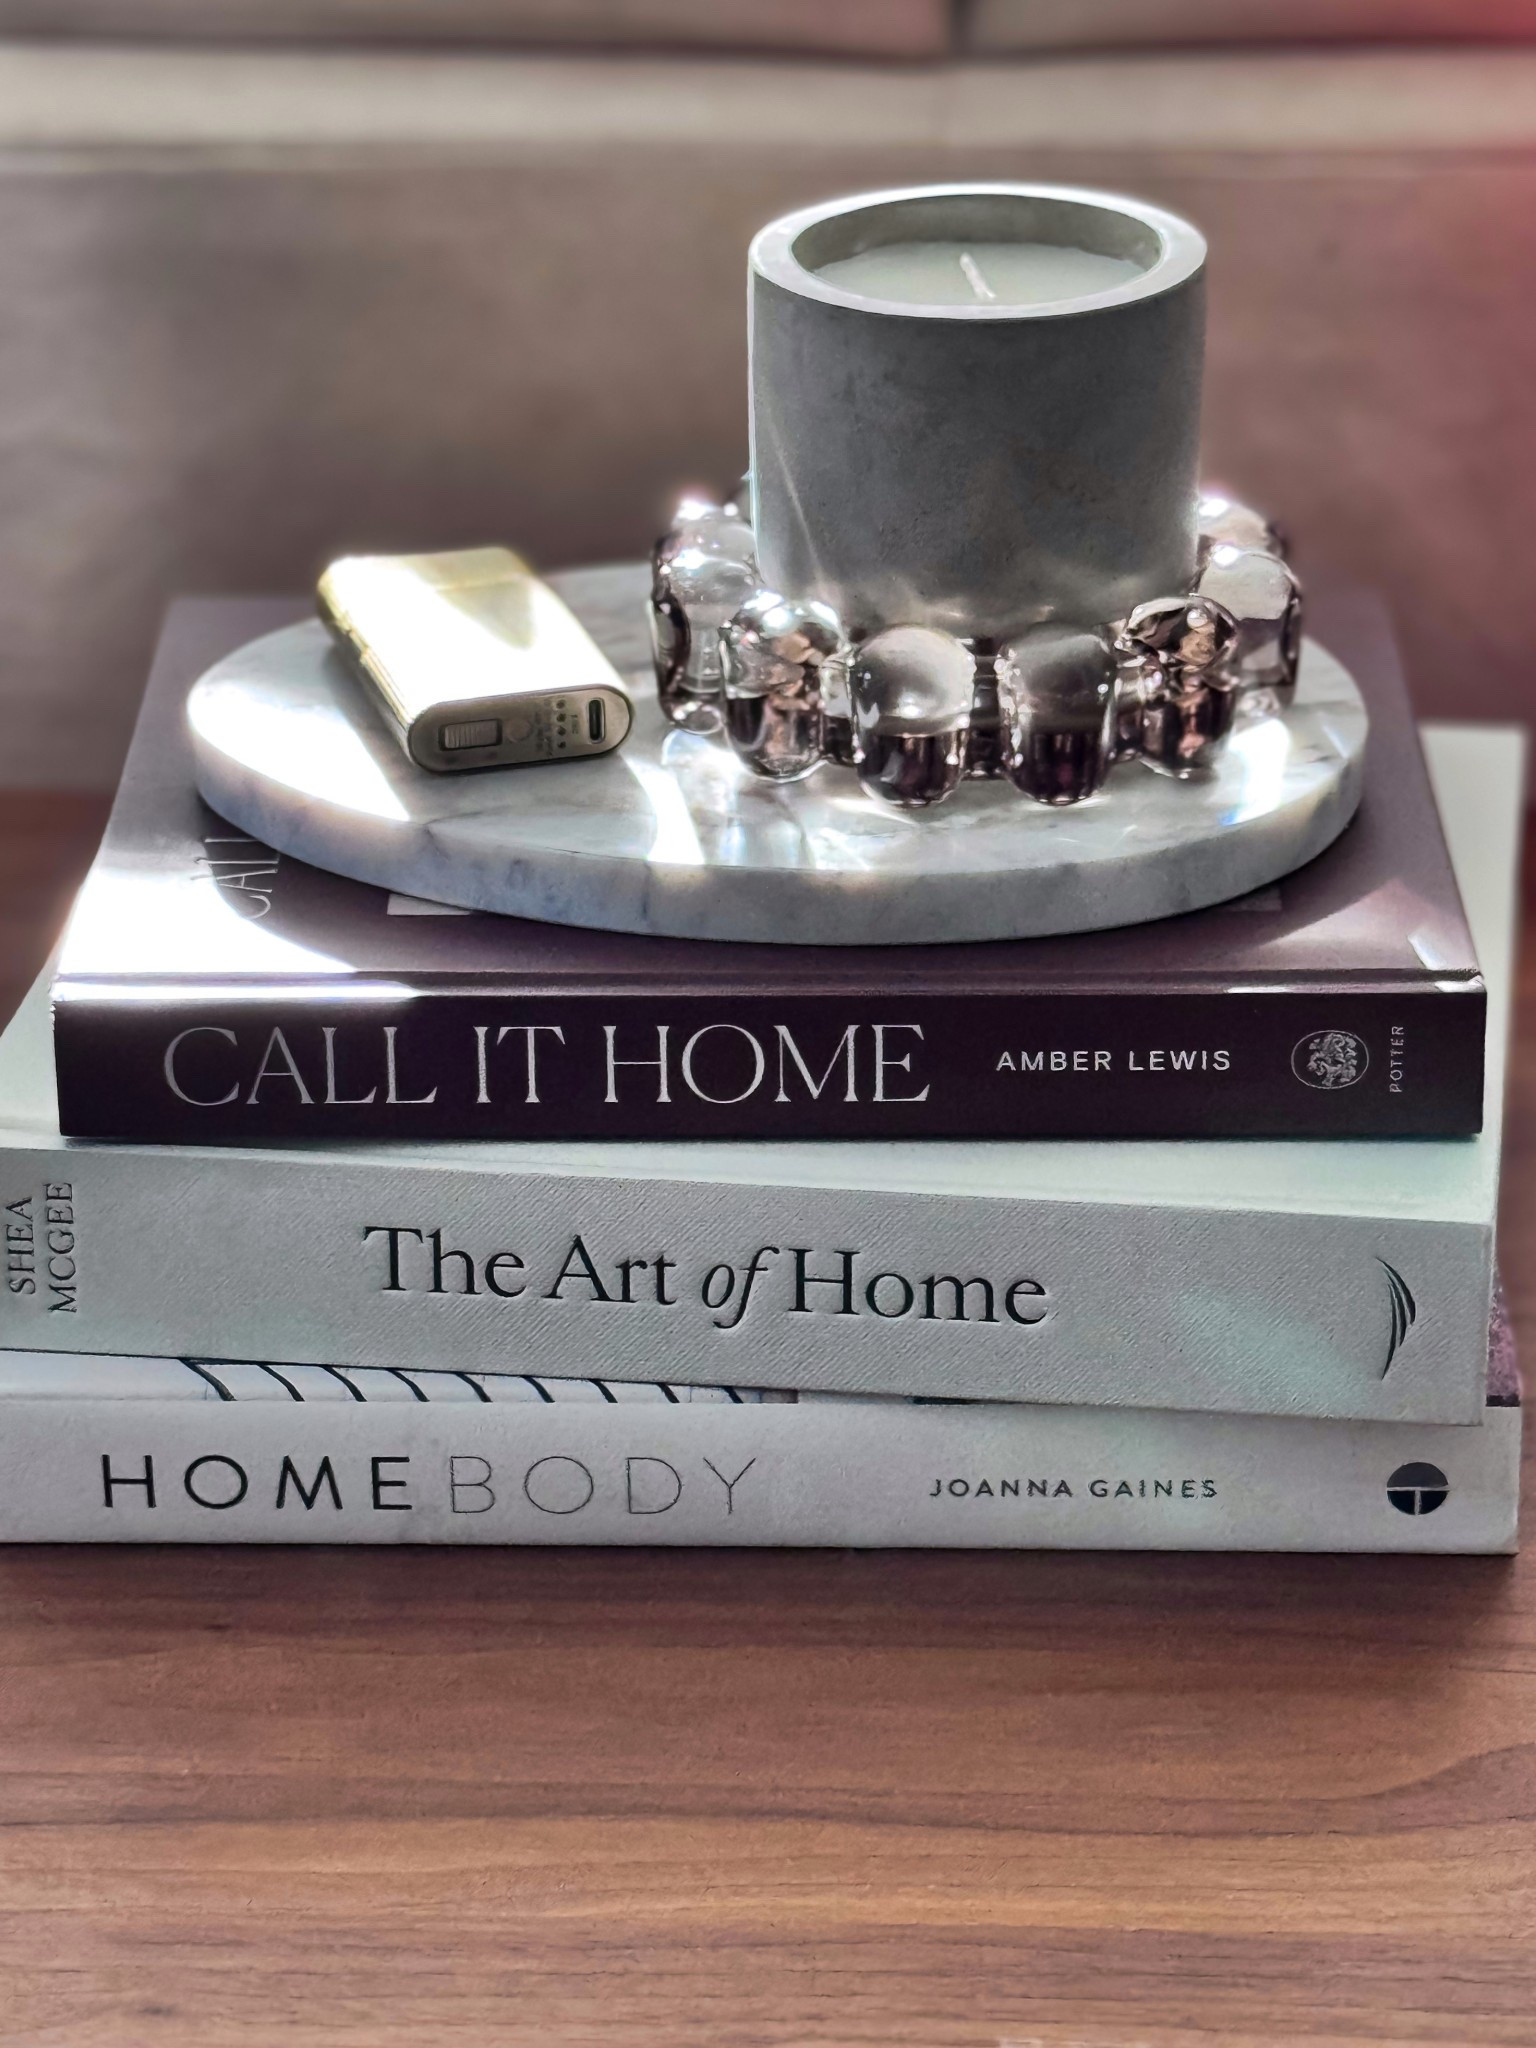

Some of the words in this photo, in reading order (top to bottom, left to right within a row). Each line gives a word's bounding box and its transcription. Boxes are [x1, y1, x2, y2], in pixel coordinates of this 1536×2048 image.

[163, 1026, 438, 1106] CALL
[472, 1025, 566, 1104] IT
[602, 1023, 931, 1104] HOME
[995, 1050, 1112, 1072] AMBER
[1128, 1049, 1231, 1072] LEWIS
[1389, 1025, 1405, 1093] POTTER
[5, 1197, 36, 1295] SHEA
[45, 1182, 78, 1313] MCGEE
[363, 1225, 527, 1299] The
[549, 1234, 678, 1306] Art
[700, 1245, 778, 1329] of
[786, 1248, 1048, 1325] Home
[929, 1478, 1074, 1498] JOANNA
[1088, 1478, 1218, 1500] GAINES
